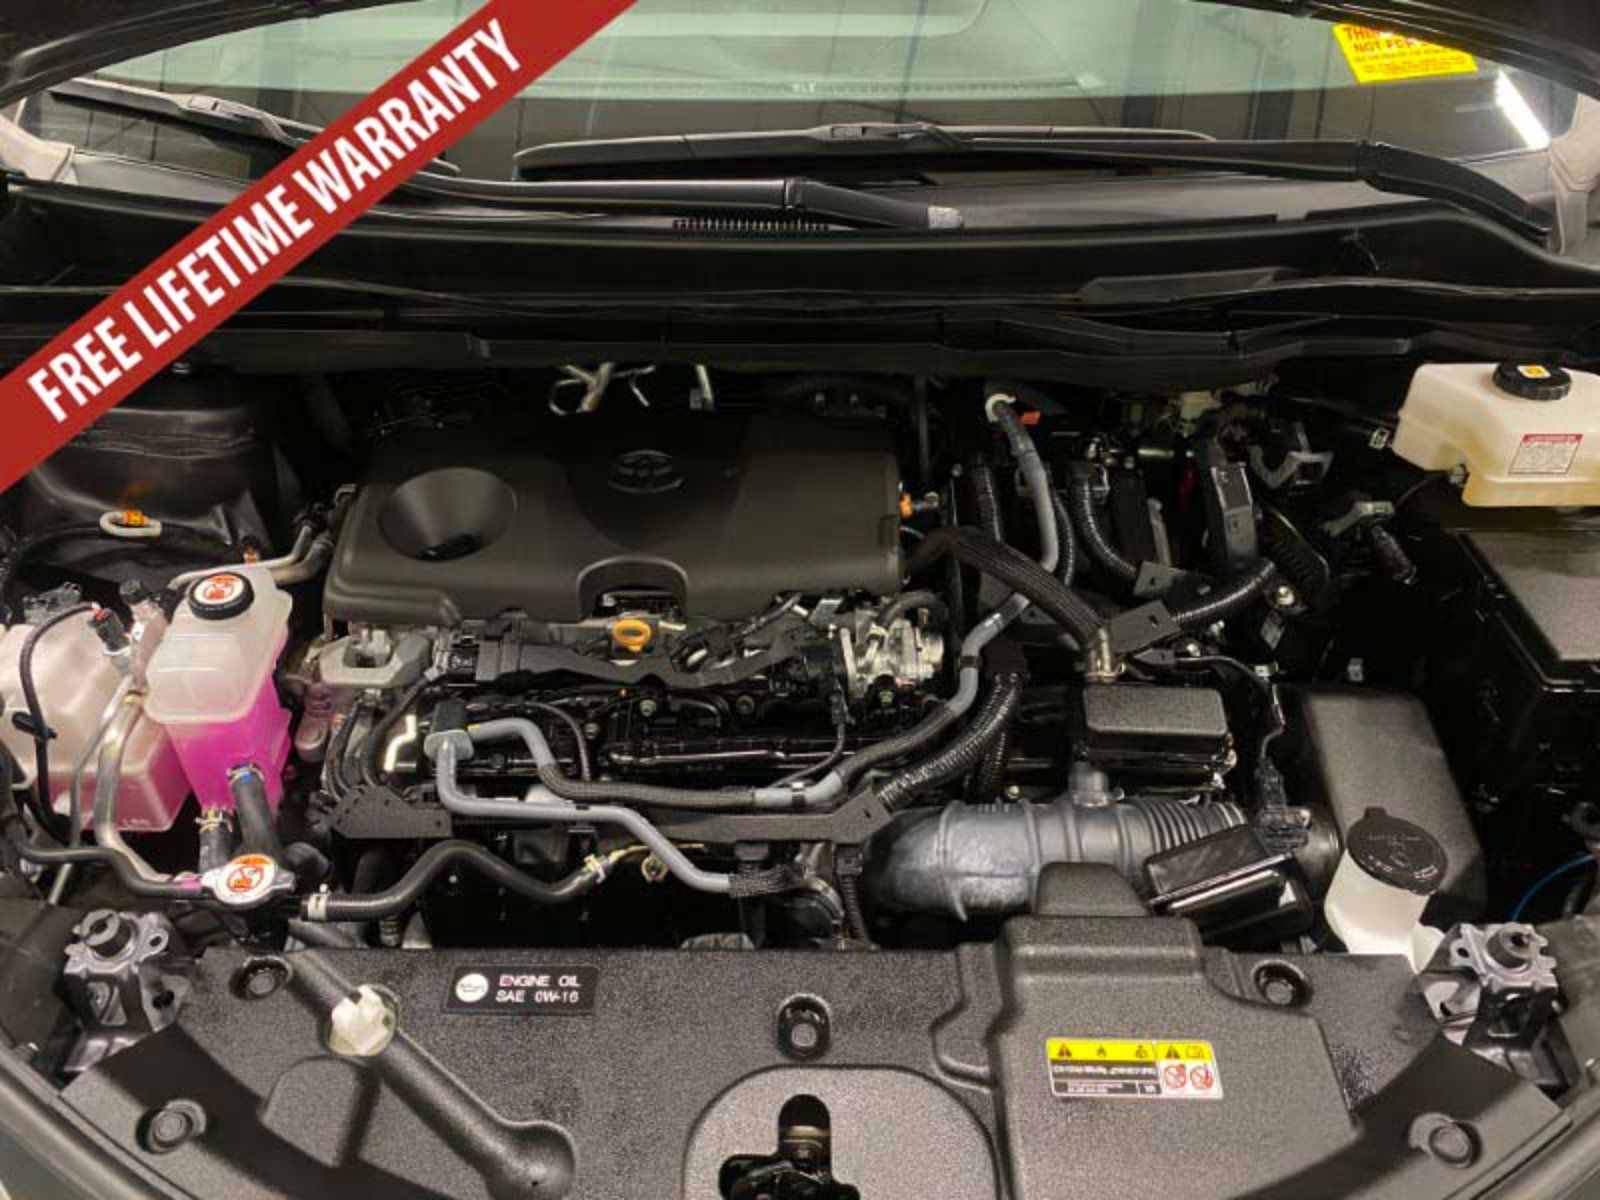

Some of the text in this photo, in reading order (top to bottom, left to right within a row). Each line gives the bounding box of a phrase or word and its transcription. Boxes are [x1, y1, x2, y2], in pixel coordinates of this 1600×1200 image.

[500, 974, 581, 987] ENGINE OIL
[496, 990, 525, 1003] SAE
